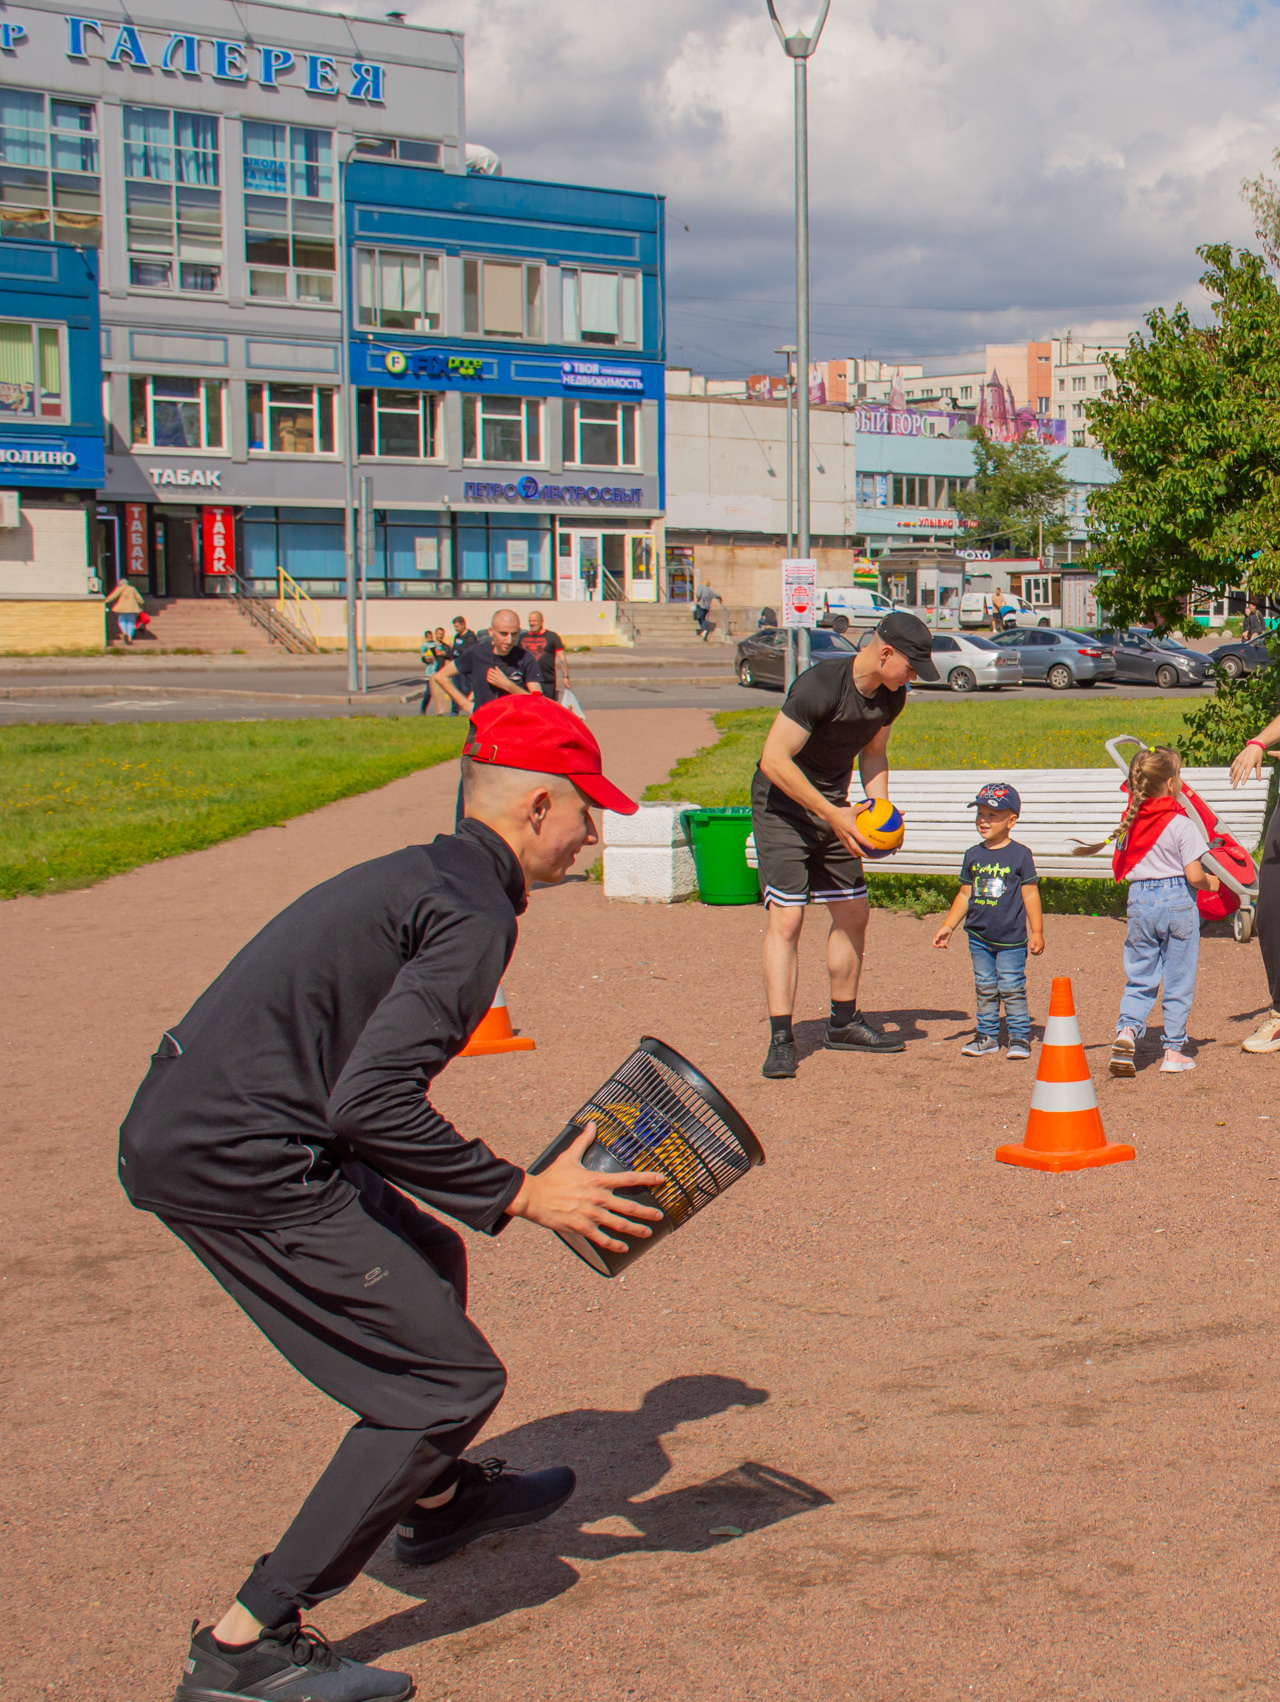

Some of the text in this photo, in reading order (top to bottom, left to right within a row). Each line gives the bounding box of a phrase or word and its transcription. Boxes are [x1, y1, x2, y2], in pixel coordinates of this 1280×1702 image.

[65, 15, 386, 103] ГАЛЕРЕЯ
[562, 375, 643, 390] НЕДВИЖИМОСТЬ
[574, 362, 600, 375] ТВОЯ
[149, 467, 222, 487] ТАБАК
[130, 506, 145, 572] ТАБАК
[212, 508, 227, 573] ТАБАК
